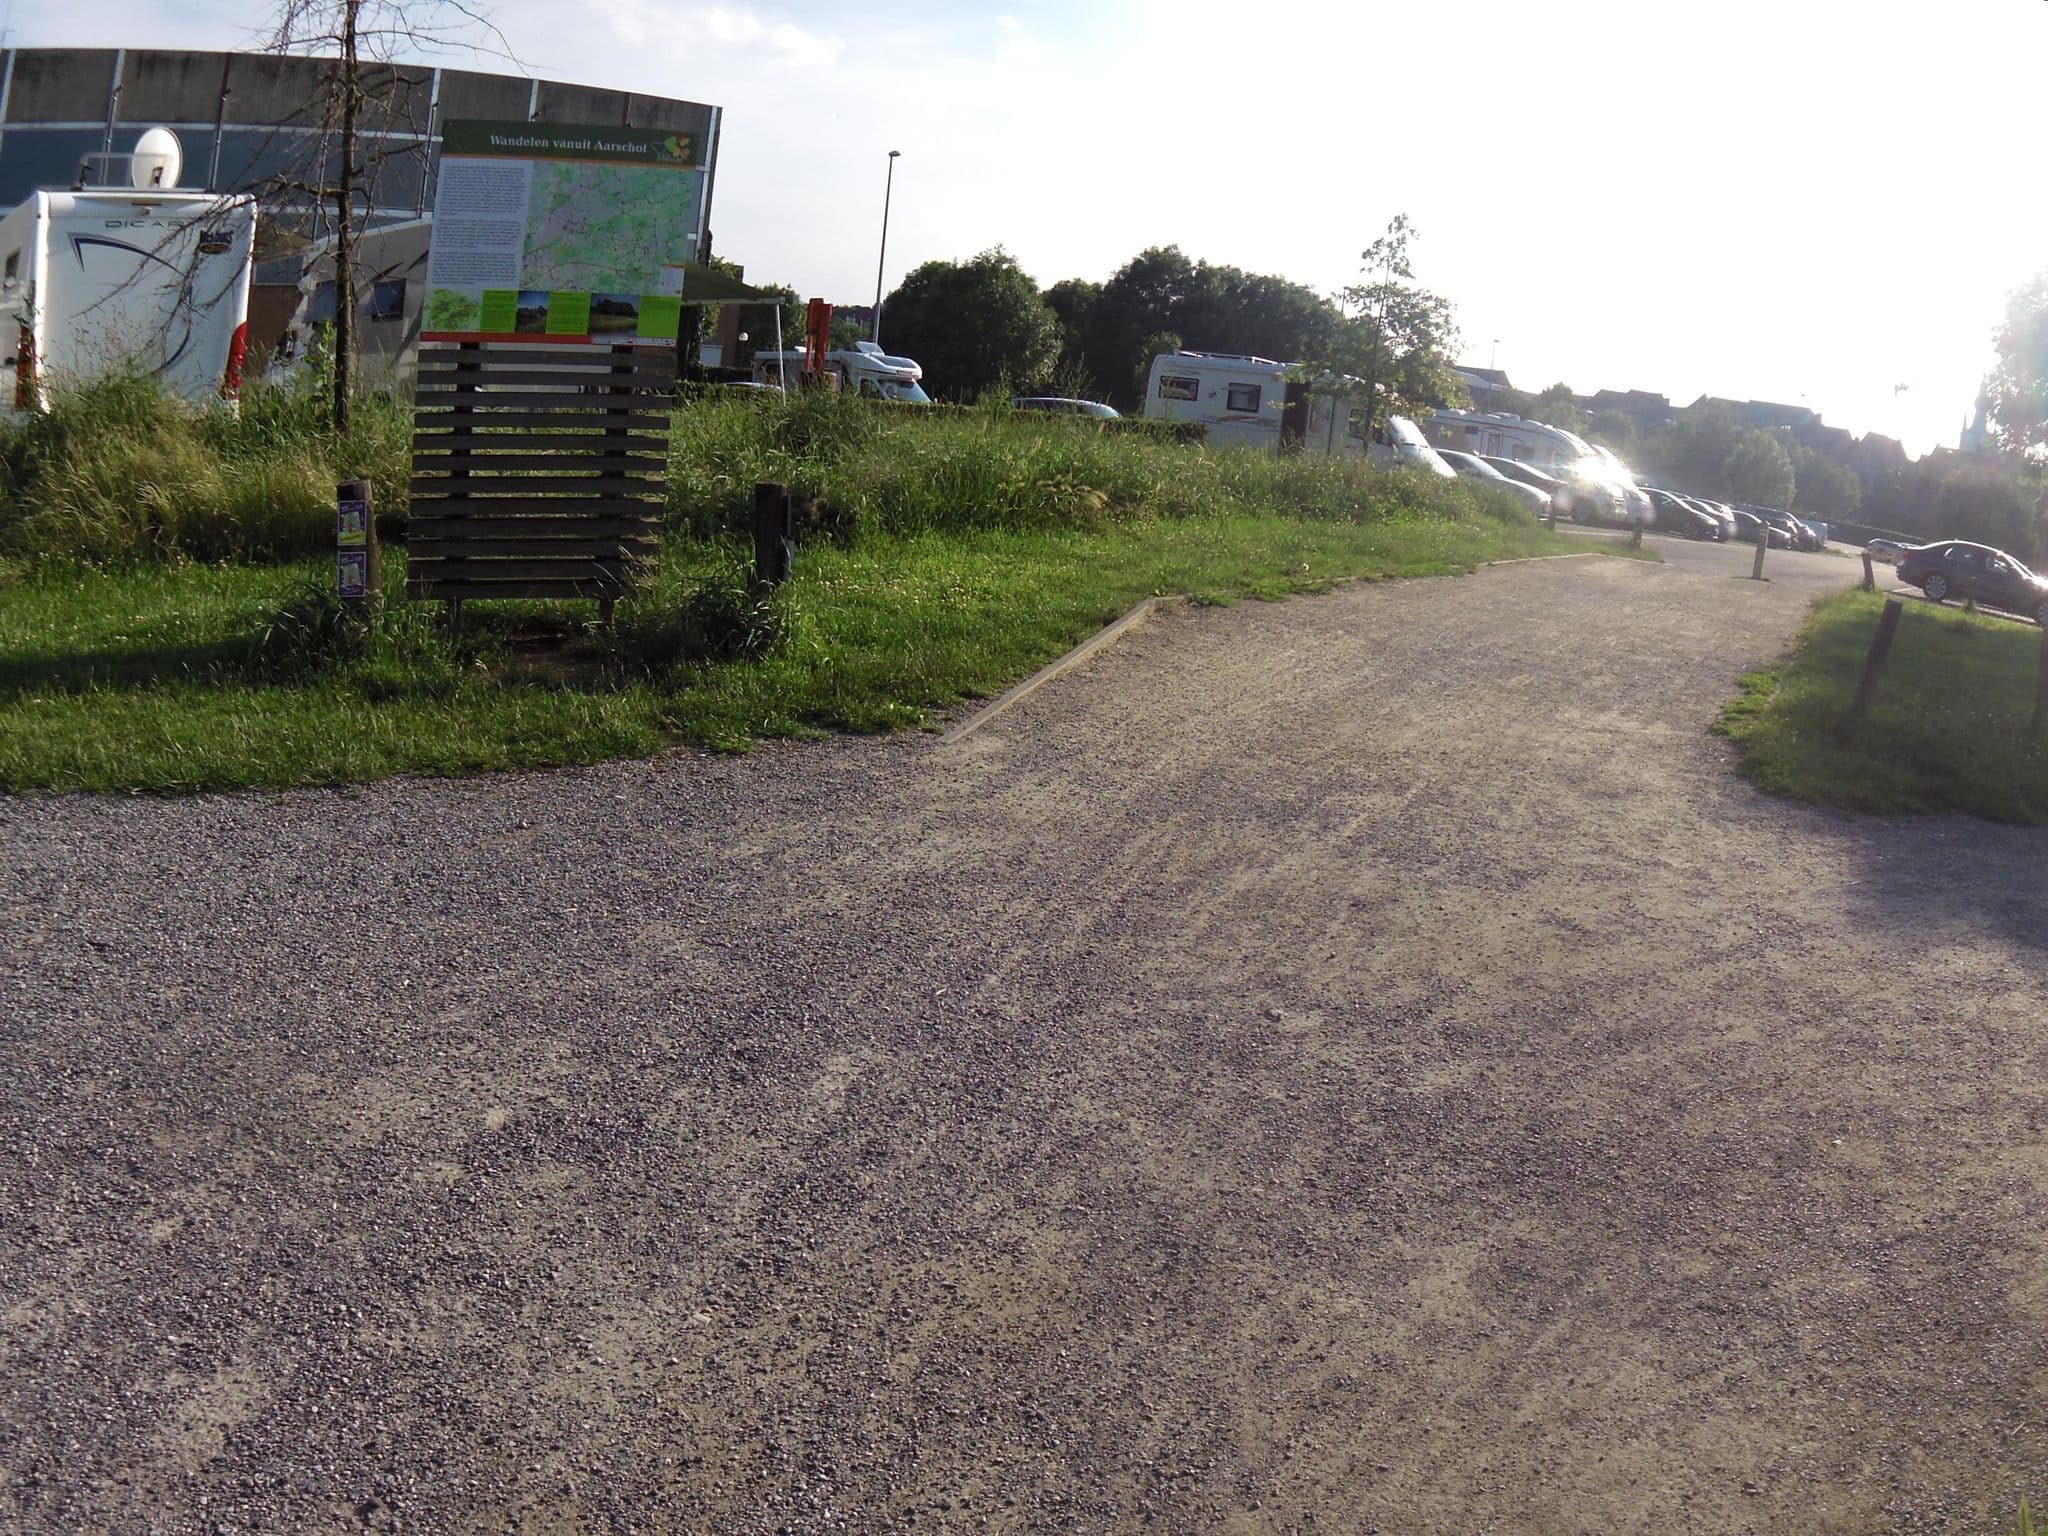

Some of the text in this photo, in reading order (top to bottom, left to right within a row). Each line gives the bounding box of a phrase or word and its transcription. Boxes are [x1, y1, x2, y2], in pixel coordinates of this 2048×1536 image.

[489, 135, 648, 153] Wandelen vanuit Aarschot
